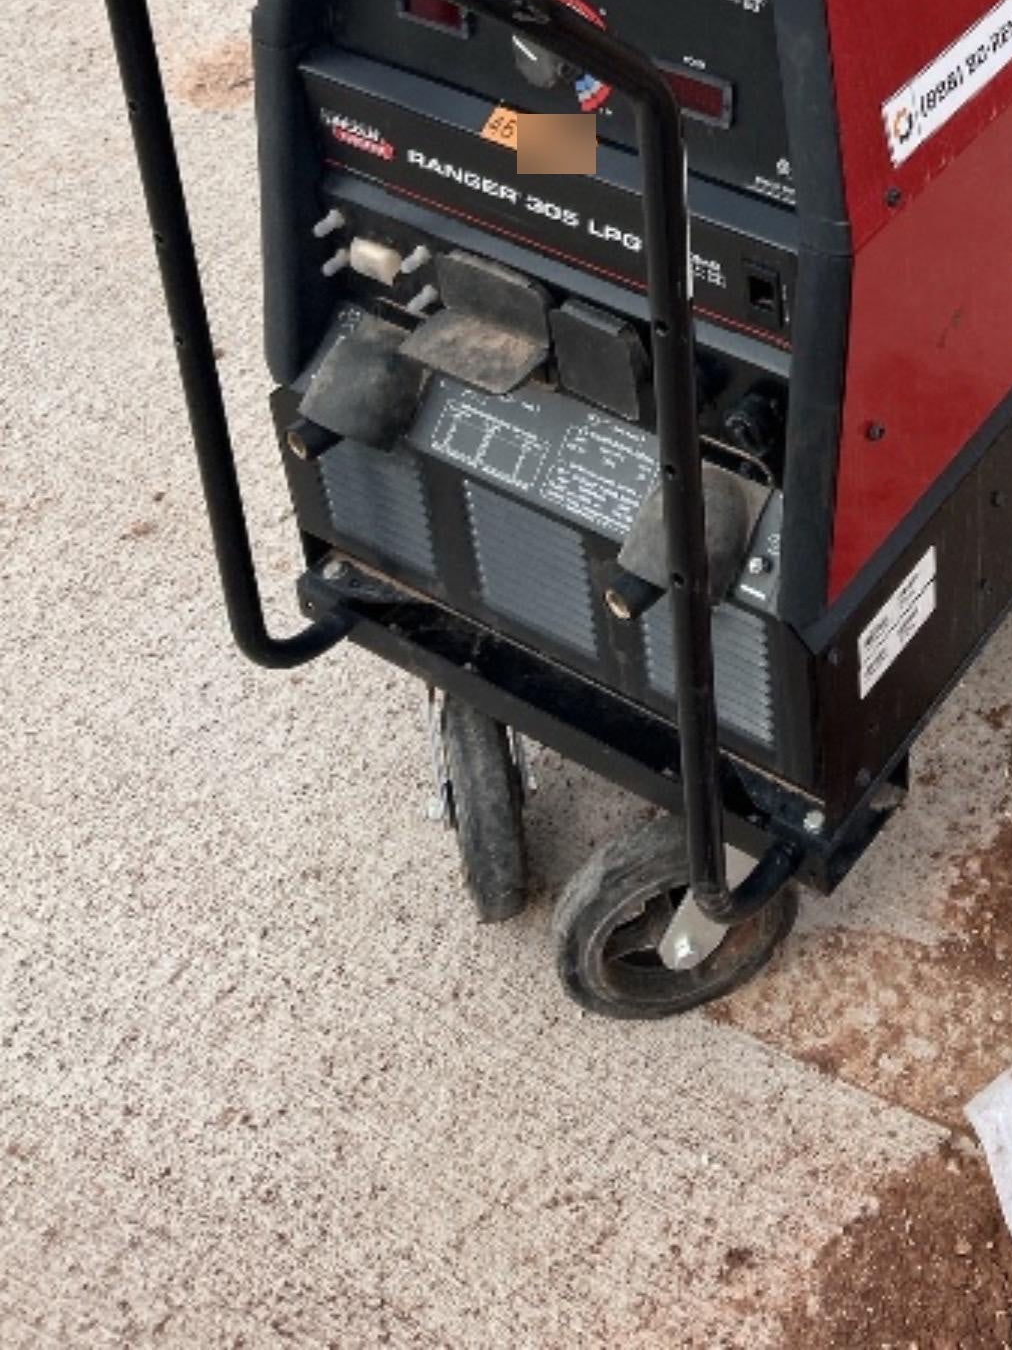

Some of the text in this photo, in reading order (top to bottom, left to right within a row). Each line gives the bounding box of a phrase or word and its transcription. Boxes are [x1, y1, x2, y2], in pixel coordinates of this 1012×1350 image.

[406, 149, 644, 253] RANGER 305 LPG
